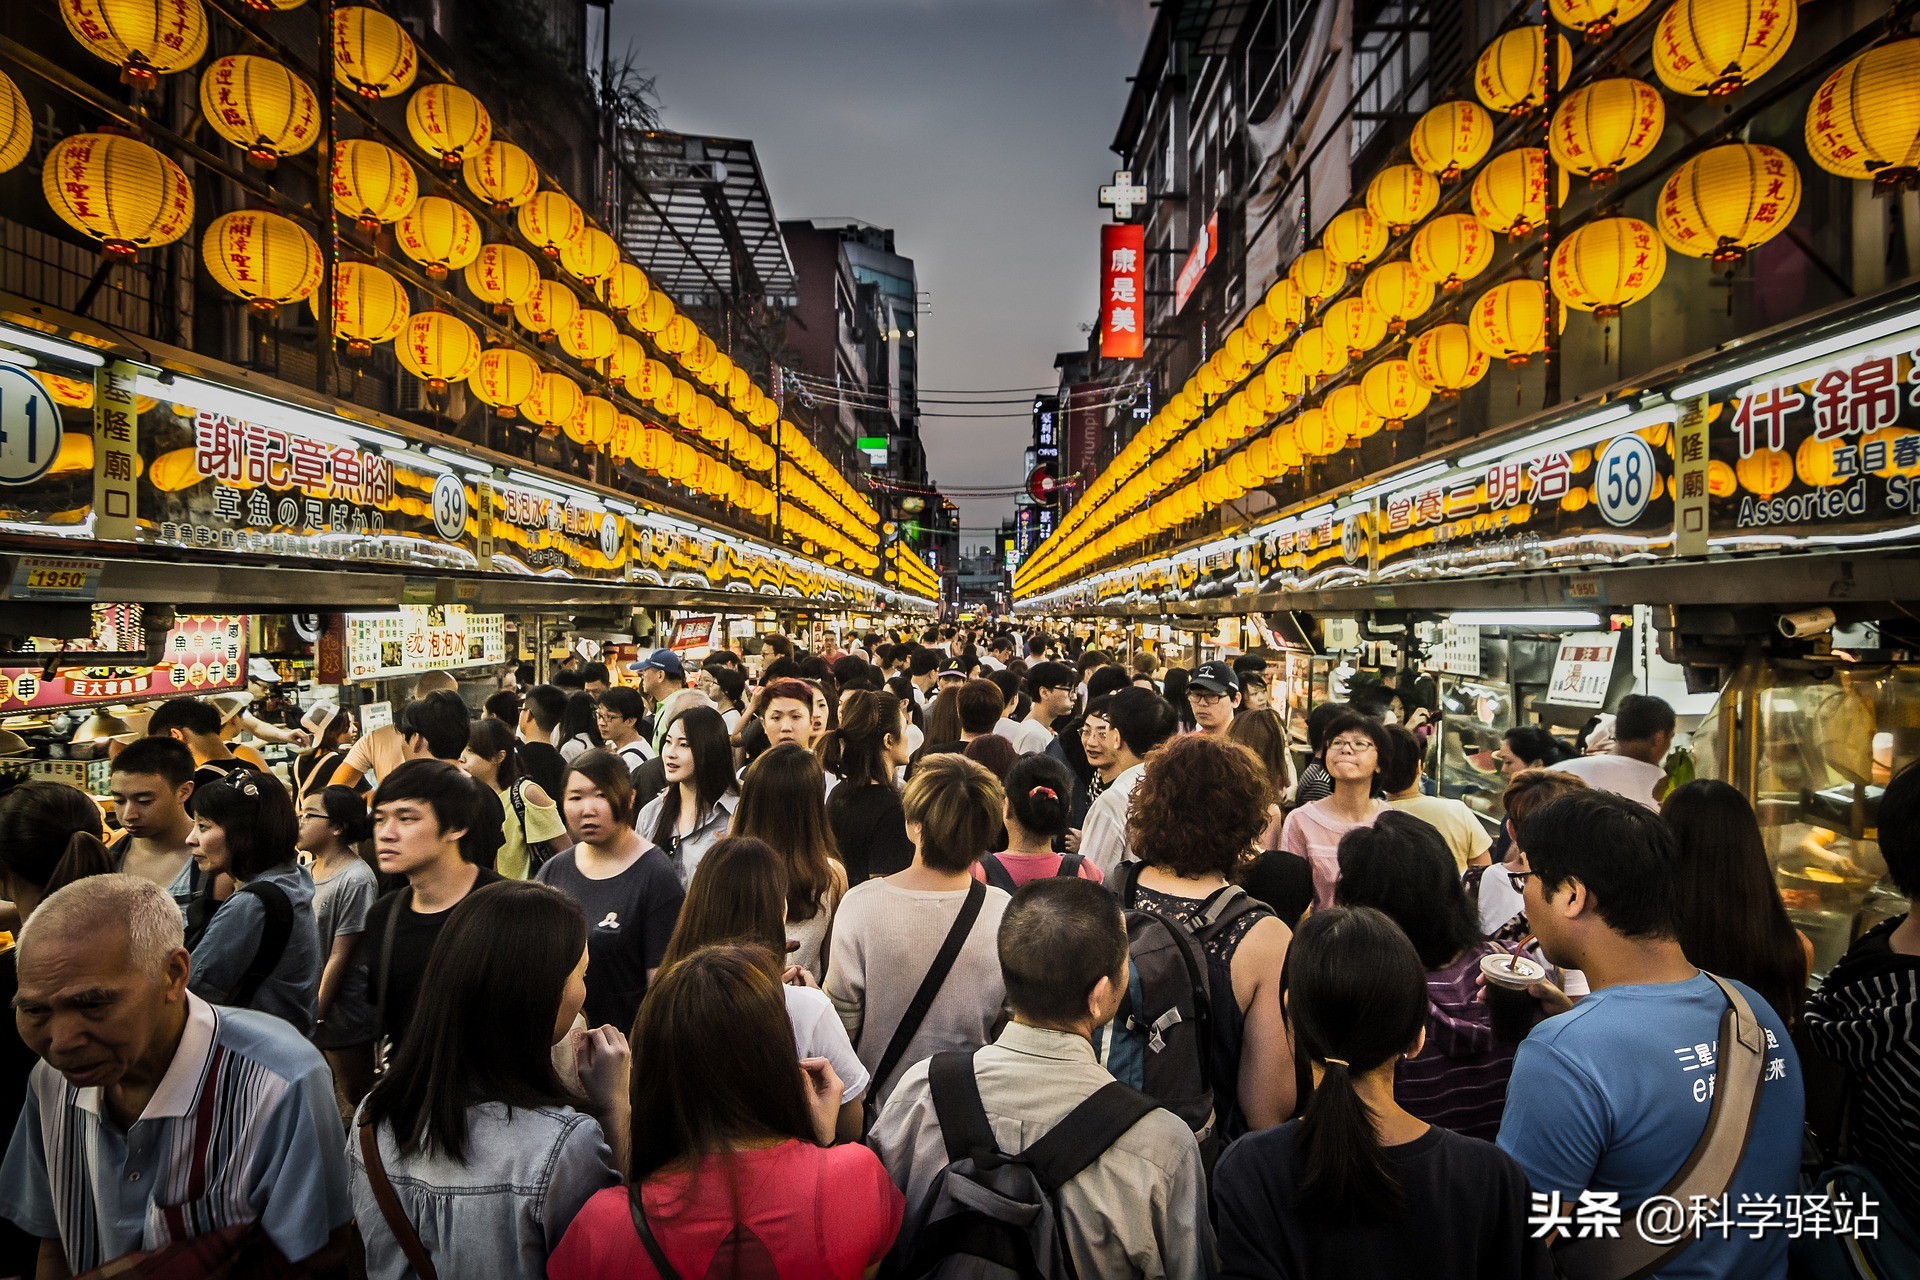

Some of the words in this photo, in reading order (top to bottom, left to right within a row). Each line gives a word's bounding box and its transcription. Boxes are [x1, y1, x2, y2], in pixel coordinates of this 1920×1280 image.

[1111, 247, 1136, 333] 康是美
[104, 369, 132, 519] 基隆廟口
[196, 411, 394, 508] 謝記章魚腳
[1082, 407, 1099, 468] Triumph
[1831, 434, 1920, 479] 五目春
[1608, 451, 1642, 510] 58
[1681, 396, 1704, 533] 基隆廟口
[213, 486, 385, 536] 章魚の足ばかり
[440, 484, 462, 530] 39
[1387, 450, 1571, 533] 營養三明治
[1737, 478, 1866, 528] Assorted
[604, 523, 616, 553] 37
[1346, 522, 1358, 554] 56
[36, 570, 82, 587] 1950
[428, 628, 467, 658] 泡泡冰
